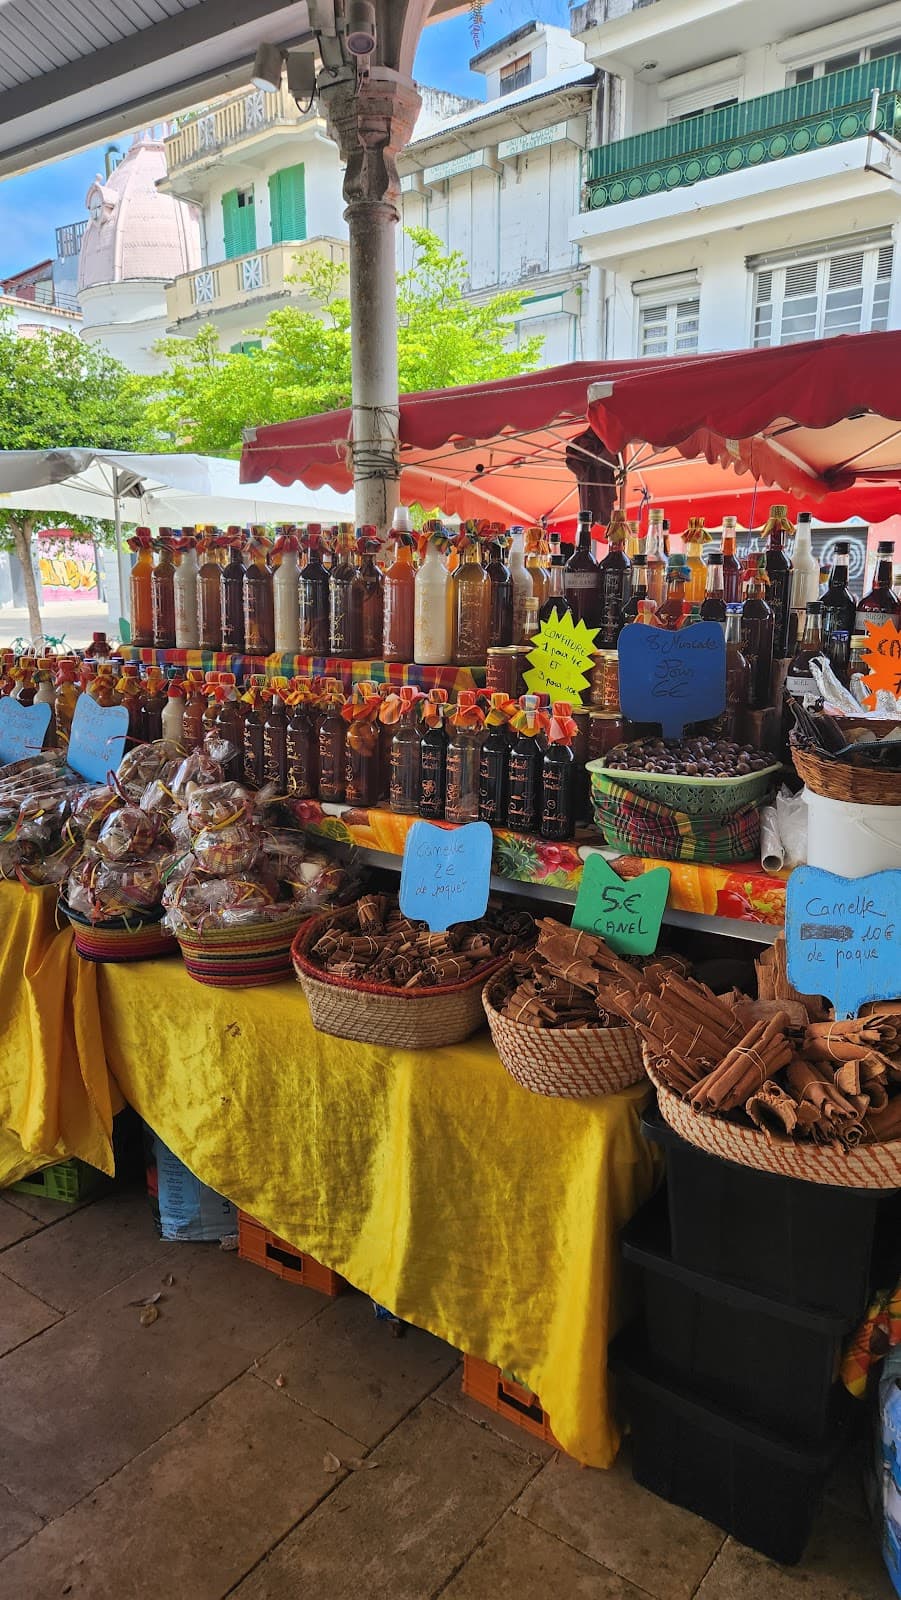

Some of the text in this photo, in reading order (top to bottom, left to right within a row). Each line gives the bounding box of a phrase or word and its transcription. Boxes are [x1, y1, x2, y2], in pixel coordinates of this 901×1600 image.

[542, 642, 549, 652] 1
[544, 630, 586, 657] CONFITURE
[550, 660, 560, 670] ET
[415, 879, 427, 895] de
[593, 917, 648, 936] CANEL
[807, 942, 825, 962] de
